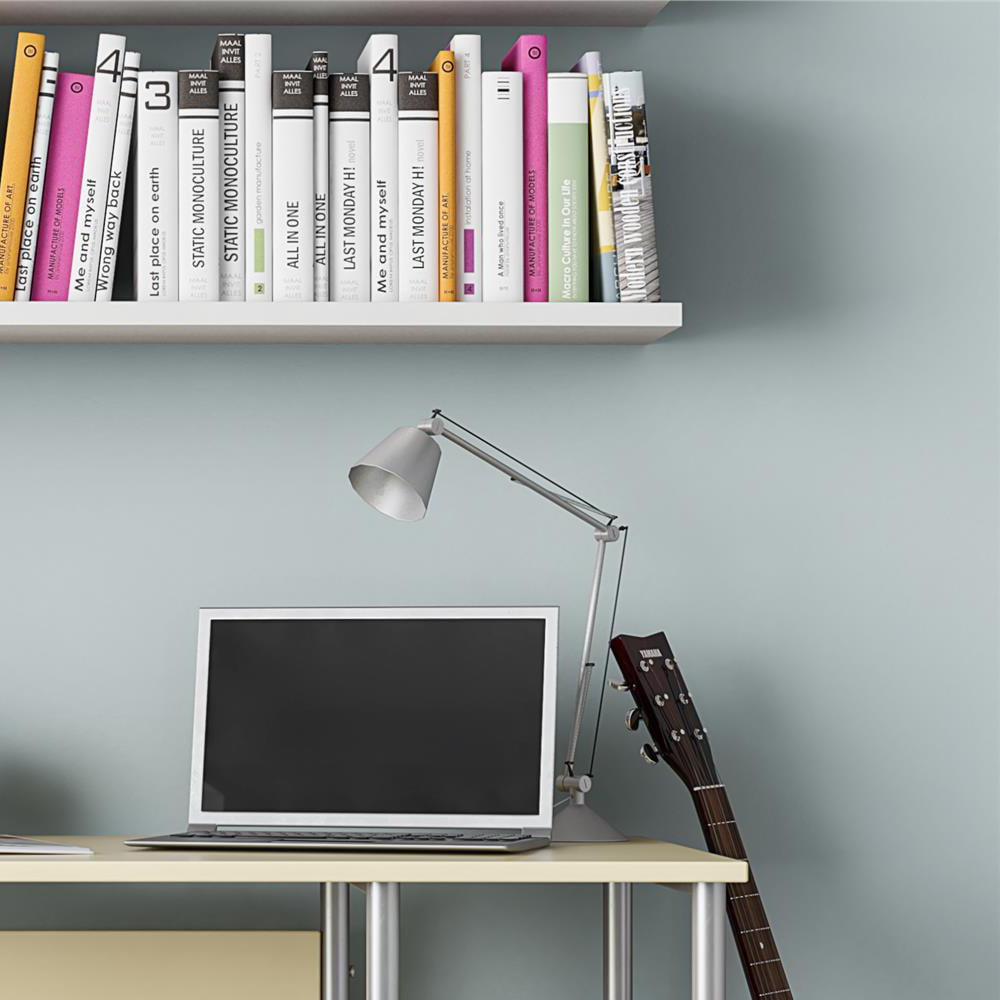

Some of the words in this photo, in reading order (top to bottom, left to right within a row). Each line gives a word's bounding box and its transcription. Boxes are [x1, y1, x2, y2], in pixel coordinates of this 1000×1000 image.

[96, 50, 122, 82] 4
[220, 56, 241, 64] ALLES
[372, 48, 398, 82] 4
[145, 81, 171, 110] 3
[224, 103, 238, 212] MONOCULTURE
[30, 156, 42, 192] earth
[150, 167, 160, 201] earth
[192, 128, 204, 224] MONOCULTURE
[344, 167, 356, 180] H!
[412, 166, 424, 180] H!
[528, 170, 536, 202] MODELS
[84, 178, 97, 228] myself
[107, 170, 122, 208] back
[4, 202, 12, 214] OF
[27, 198, 37, 214] on
[152, 206, 160, 224] on
[286, 200, 300, 228] ONE
[315, 194, 326, 222] ONE
[344, 183, 356, 238] MONDAY
[376, 180, 389, 229] myself
[412, 182, 424, 236] MONDAY
[442, 210, 448, 222] OF
[528, 204, 536, 216] OF
[561, 198, 571, 216] Our
[613, 189, 642, 244] wooden
[22, 220, 34, 261] place
[106, 212, 120, 241] way
[224, 216, 238, 262] STATIC
[287, 230, 299, 244] IN
[315, 225, 326, 239] IN
[48, 228, 60, 280] MANUFACTURE
[54, 216, 62, 228] OF
[80, 232, 90, 263] and
[150, 228, 162, 266] place
[192, 228, 204, 268] STATIC
[286, 246, 300, 268] ALL
[315, 242, 326, 266] ALL
[344, 240, 356, 270] LAST
[376, 234, 387, 264] and
[412, 240, 424, 269] LAST
[528, 218, 536, 277] MANUFACTURE
[562, 230, 572, 264] Culture
[16, 265, 28, 292] Last
[74, 266, 86, 292] Me
[97, 246, 115, 291] Wrong
[376, 269, 387, 293] Me
[562, 267, 572, 299] Macro
[150, 272, 160, 296] Last
